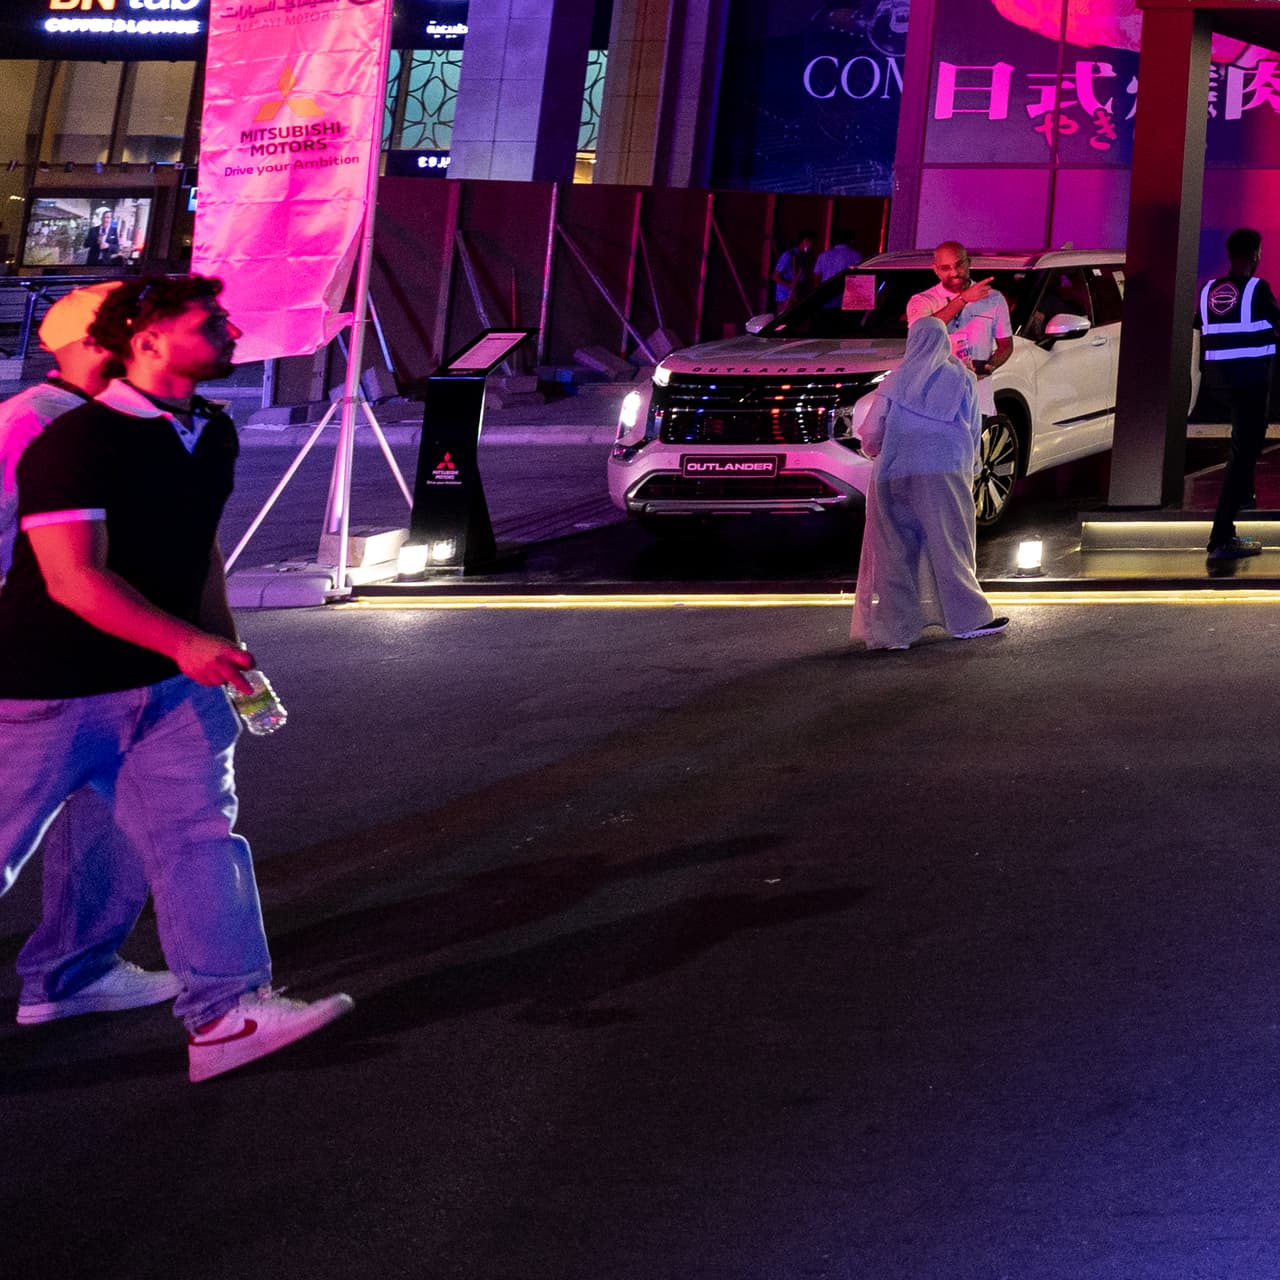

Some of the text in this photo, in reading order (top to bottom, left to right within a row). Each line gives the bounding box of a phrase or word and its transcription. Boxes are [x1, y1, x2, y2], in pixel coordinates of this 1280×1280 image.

[240, 121, 341, 144] MITSUBISHI
[250, 138, 327, 157] MOTORS
[224, 155, 360, 177] Drive your Ambition
[687, 463, 773, 471] OUTLANDER
